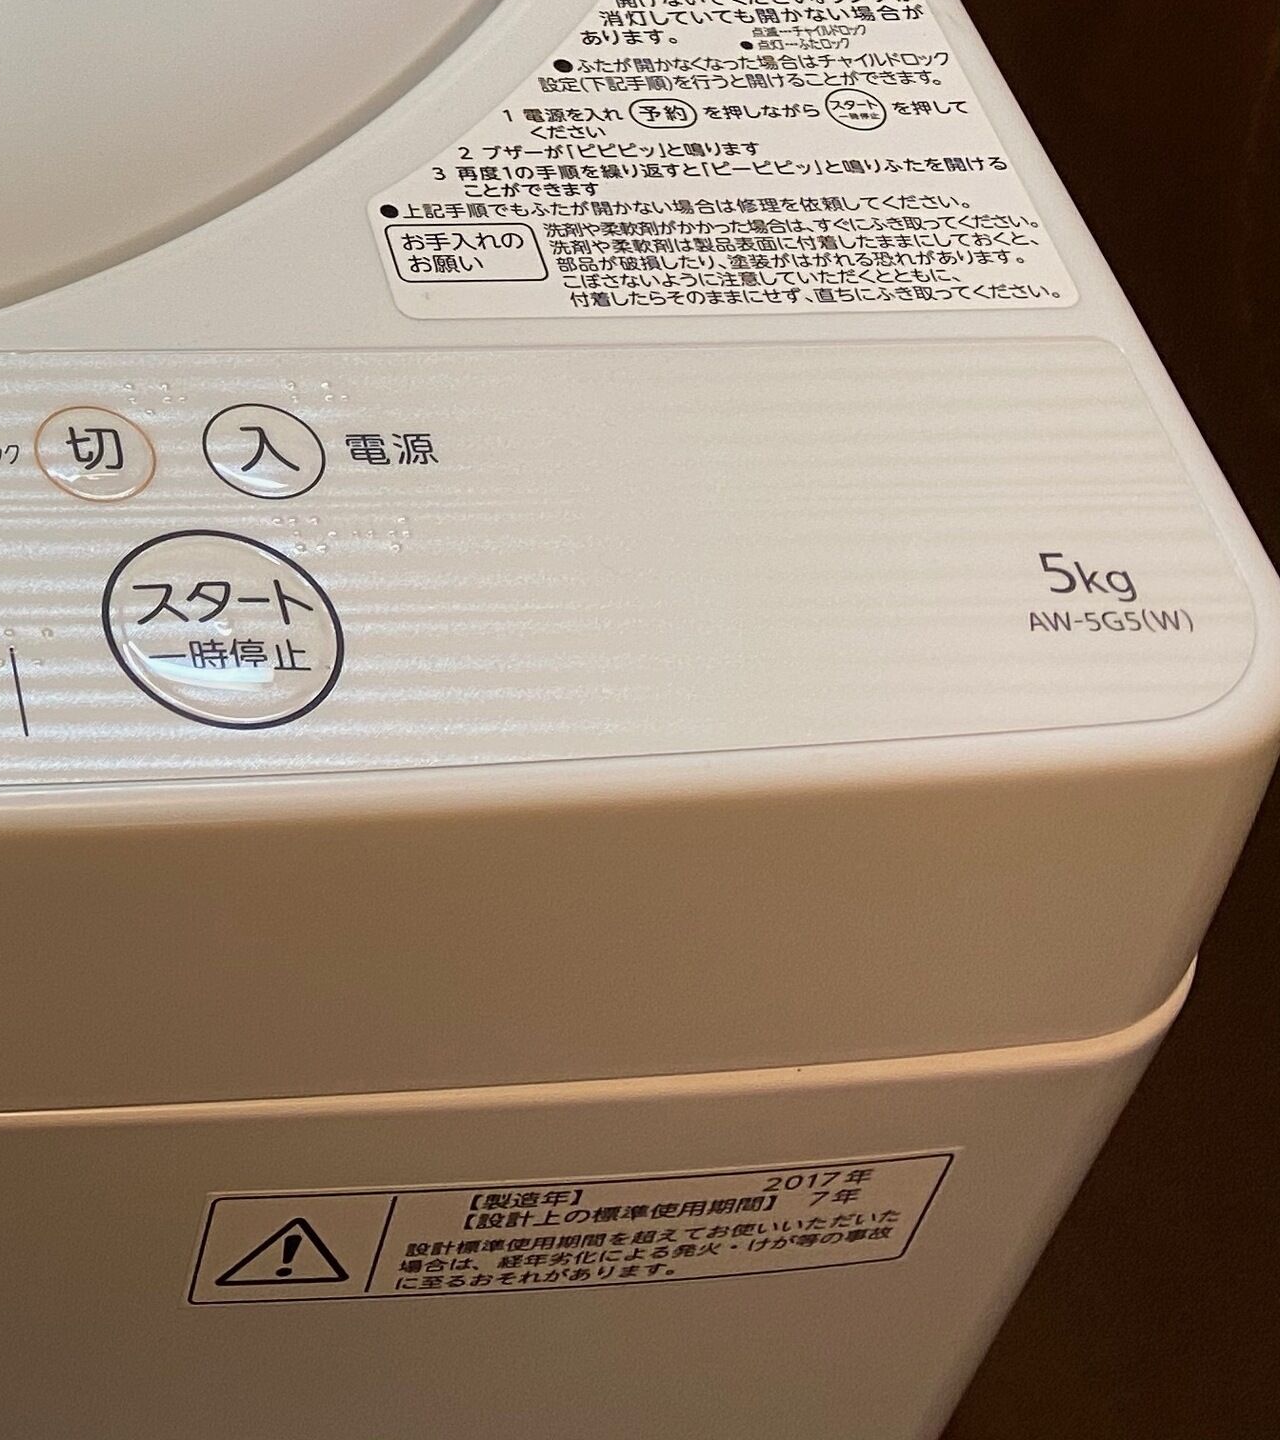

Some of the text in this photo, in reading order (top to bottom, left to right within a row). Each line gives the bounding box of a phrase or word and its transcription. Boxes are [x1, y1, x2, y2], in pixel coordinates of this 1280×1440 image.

[599, 4, 924, 27] 消灯していても開かない場合が
[580, 30, 680, 46] あります。
[503, 97, 968, 124] 1 電源を入れ 予約 を押しながら スタート を押して
[531, 123, 606, 140] ください
[459, 145, 472, 160] 2
[433, 167, 445, 181] 3
[464, 180, 597, 197] ことができます
[400, 230, 524, 251] お手入れの
[410, 252, 485, 273] お願い
[66, 426, 123, 470] 切
[239, 426, 300, 472] 入
[345, 432, 439, 465] 電源
[1039, 553, 1137, 602] 5kg
[132, 579, 314, 626] スタート
[1030, 609, 1194, 633] AW-5G5(W)
[148, 639, 312, 672] 一時停止
[761, 1167, 875, 1193] 2017年
[405, 1210, 903, 1258] 設計標準使用期間を超えてお使いいただいた
[395, 1260, 681, 1292] に至るおそれがあります。
